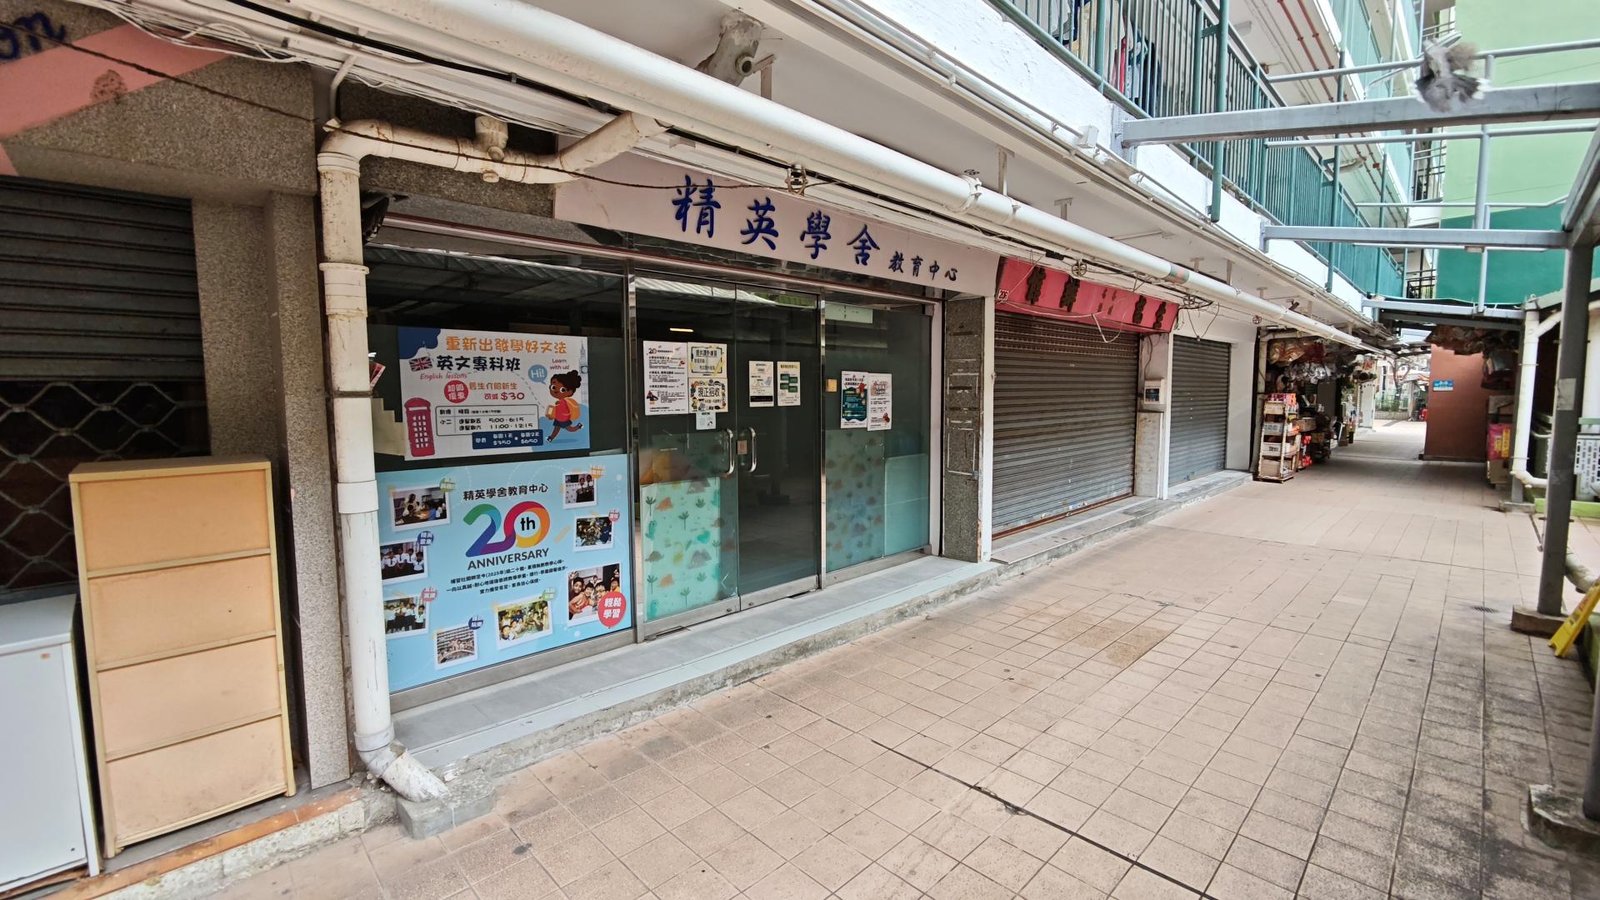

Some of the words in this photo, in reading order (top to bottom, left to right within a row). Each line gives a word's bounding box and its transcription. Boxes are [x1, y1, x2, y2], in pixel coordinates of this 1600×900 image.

[671, 174, 881, 266] 精英學舍
[888, 250, 959, 282] 教育中心
[445, 336, 567, 354] 重新出發學好文法
[436, 355, 521, 372] 英文專科班
[420, 373, 443, 381] English
[530, 367, 545, 379] Hi!
[500, 391, 525, 401] $30
[463, 483, 549, 501] 精英學舍教育中心
[467, 547, 550, 570] ANNIVERSARY
